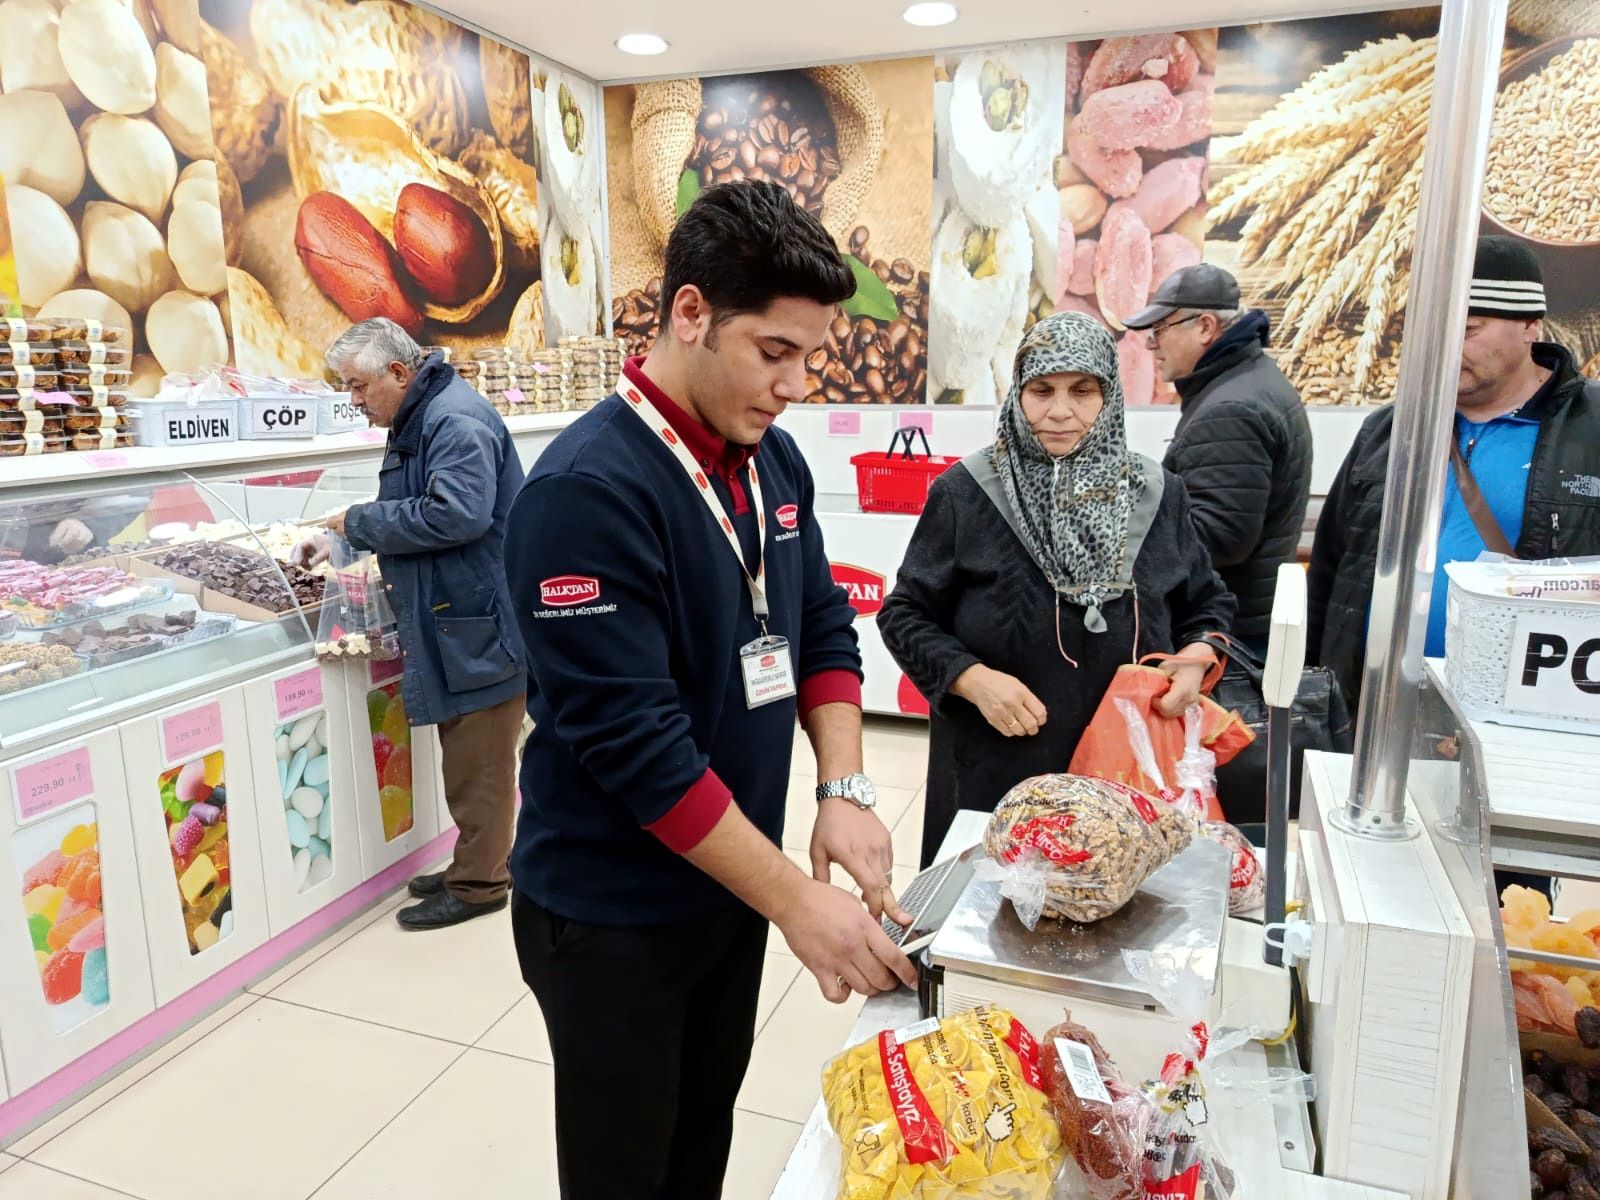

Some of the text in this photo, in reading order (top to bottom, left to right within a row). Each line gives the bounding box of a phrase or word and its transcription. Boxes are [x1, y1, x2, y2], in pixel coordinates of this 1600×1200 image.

[262, 405, 307, 430] ÇÖP
[333, 402, 362, 422] POŞE
[168, 414, 230, 440] ELDİVEN
[1561, 480, 1592, 489] NORTH
[1574, 474, 1592, 483] THE
[1570, 487, 1592, 496] FACE
[542, 582, 595, 597] HALKTAN
[961, 1102, 978, 1136] kadar
